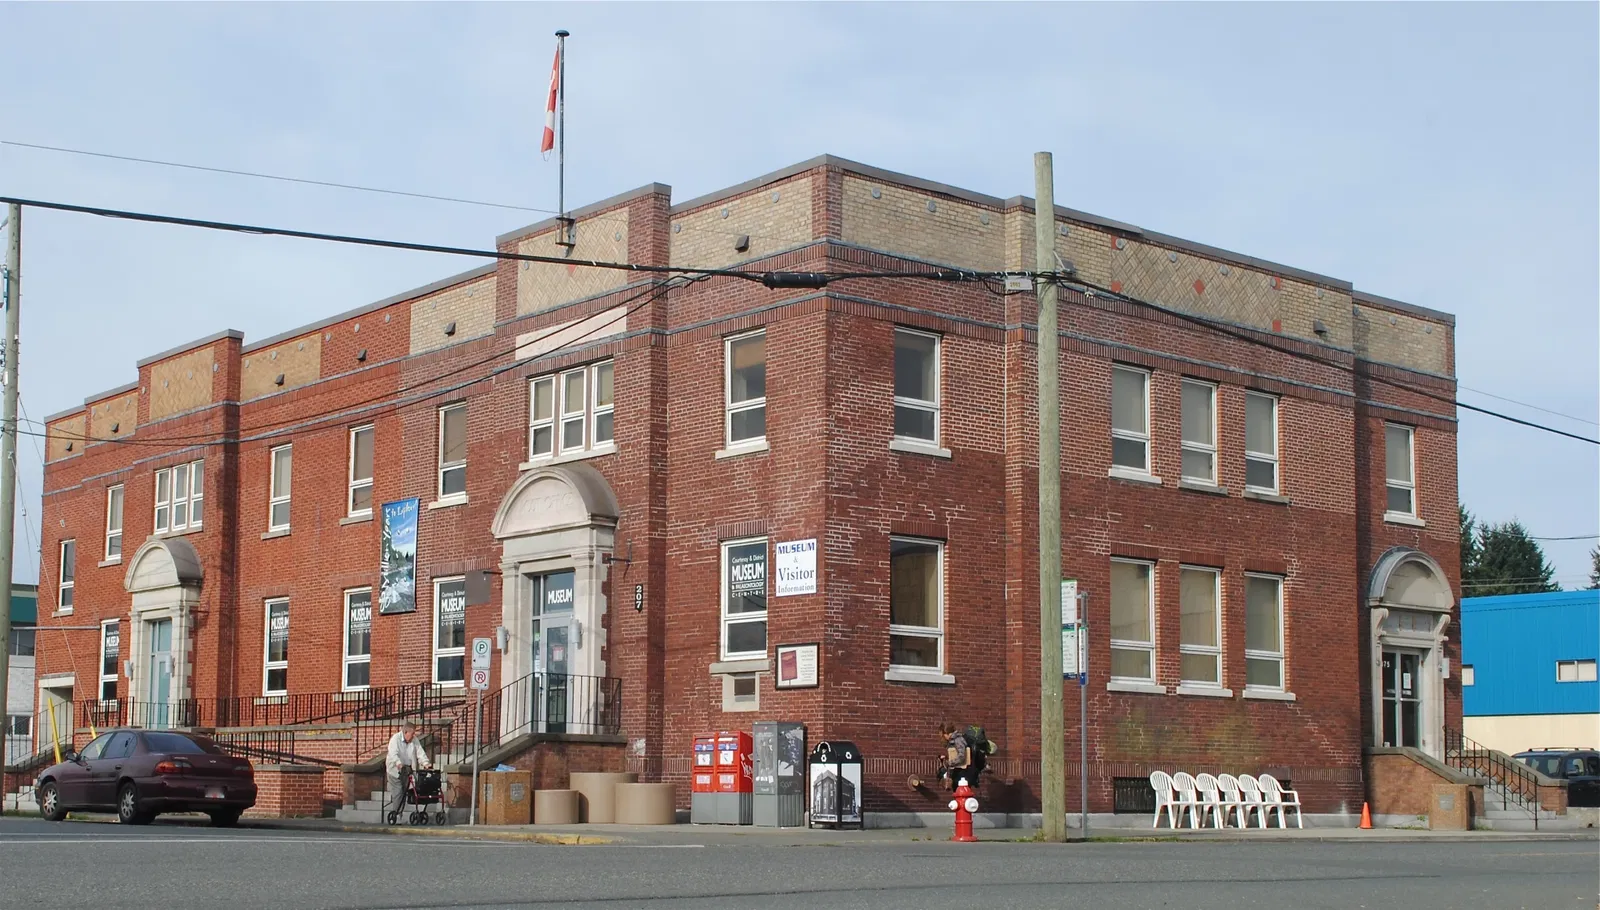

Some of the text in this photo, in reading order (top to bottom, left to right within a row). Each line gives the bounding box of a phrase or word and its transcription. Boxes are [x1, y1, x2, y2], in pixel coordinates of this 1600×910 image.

[778, 542, 815, 554] MUSEUM
[732, 562, 764, 581] MUSEUM
[778, 567, 814, 581] Visitor
[778, 583, 815, 593] Information
[548, 588, 573, 604] MUSEUM
[441, 597, 465, 612] MUSEUM
[351, 607, 372, 622] MUSEUM
